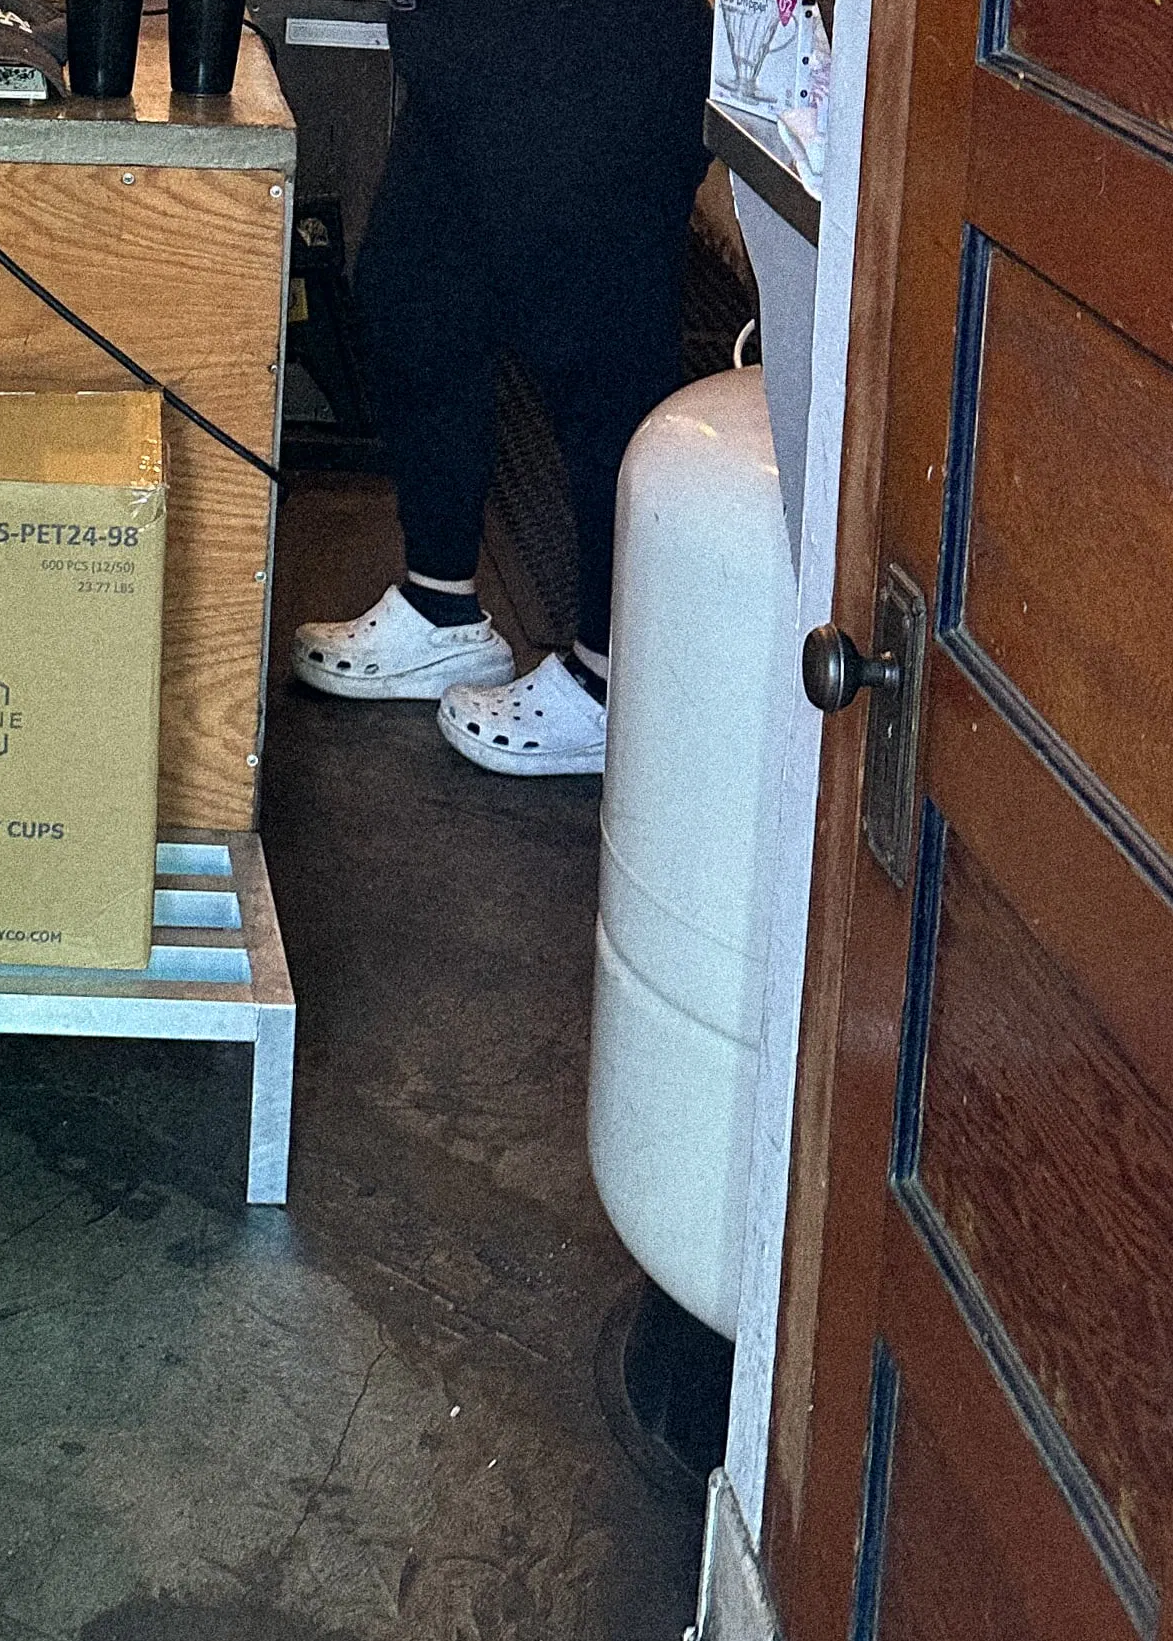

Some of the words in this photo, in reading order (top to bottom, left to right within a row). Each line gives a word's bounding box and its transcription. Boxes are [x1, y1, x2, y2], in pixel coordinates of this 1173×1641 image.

[41, 560, 64, 571] 600
[67, 561, 88, 571] PCS
[91, 561, 135, 574] (12/50)
[114, 582, 135, 594] LBS
[7, 821, 65, 839] CUPS
